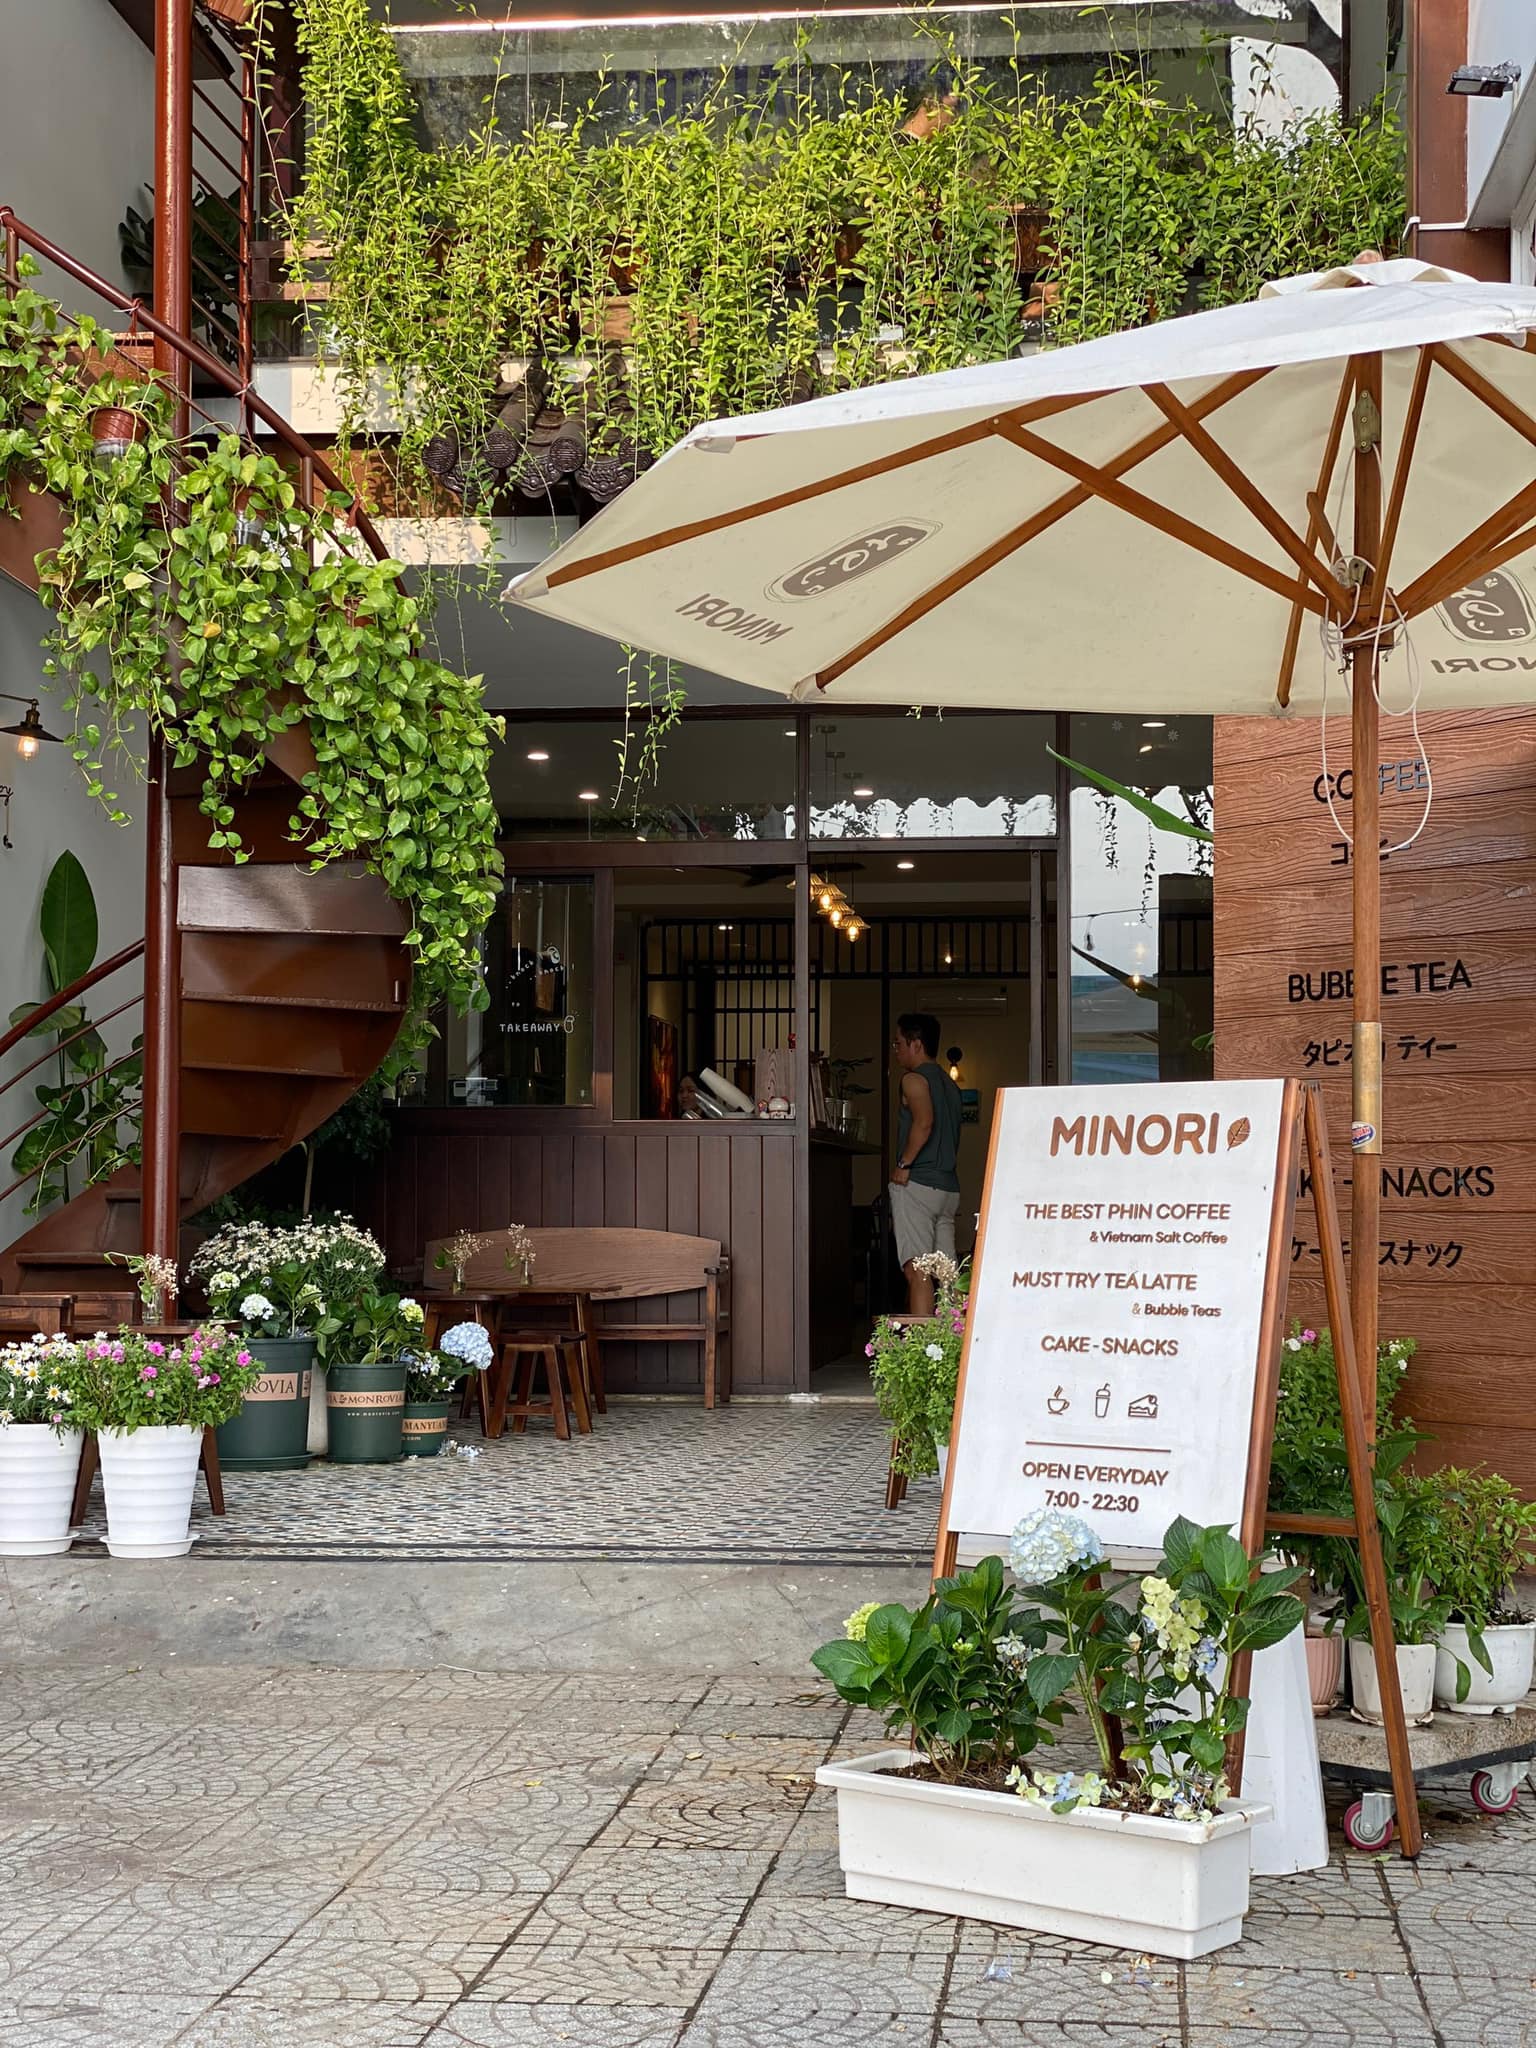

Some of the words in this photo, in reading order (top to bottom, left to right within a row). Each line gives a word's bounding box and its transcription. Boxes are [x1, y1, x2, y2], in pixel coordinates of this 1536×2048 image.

[1313, 757, 1432, 803] COFEE
[1287, 965, 1399, 1002] BUBE
[1407, 959, 1473, 994] TEA
[1050, 1112, 1220, 1157] MINORI
[1380, 1166, 1495, 1198] NACKS
[1024, 1203, 1058, 1220] THE
[1061, 1203, 1105, 1220] BEST
[1108, 1203, 1152, 1220] PHIN
[1156, 1203, 1231, 1220] COFFEE
[1089, 1231, 1098, 1243] &
[1101, 1231, 1153, 1243] Vietnam
[1155, 1231, 1181, 1243] Salt
[1183, 1231, 1228, 1244] Coffee
[1012, 1271, 1062, 1288] MUST
[1065, 1272, 1100, 1288] TRY
[1105, 1273, 1139, 1289] TEA
[1142, 1273, 1198, 1291] LATTE
[1132, 1302, 1141, 1315] &
[1144, 1303, 1188, 1316] Bubble
[1191, 1304, 1221, 1317] Teas
[1041, 1335, 1090, 1352] CAKE
[1102, 1337, 1178, 1356] SNACKS
[245, 1379, 294, 1394] ROVIA
[1022, 1461, 1070, 1480] OPEN
[1074, 1464, 1168, 1486] EVERYDAY
[1045, 1489, 1079, 1508] 7:00
[1092, 1493, 1139, 1513] 22:30
